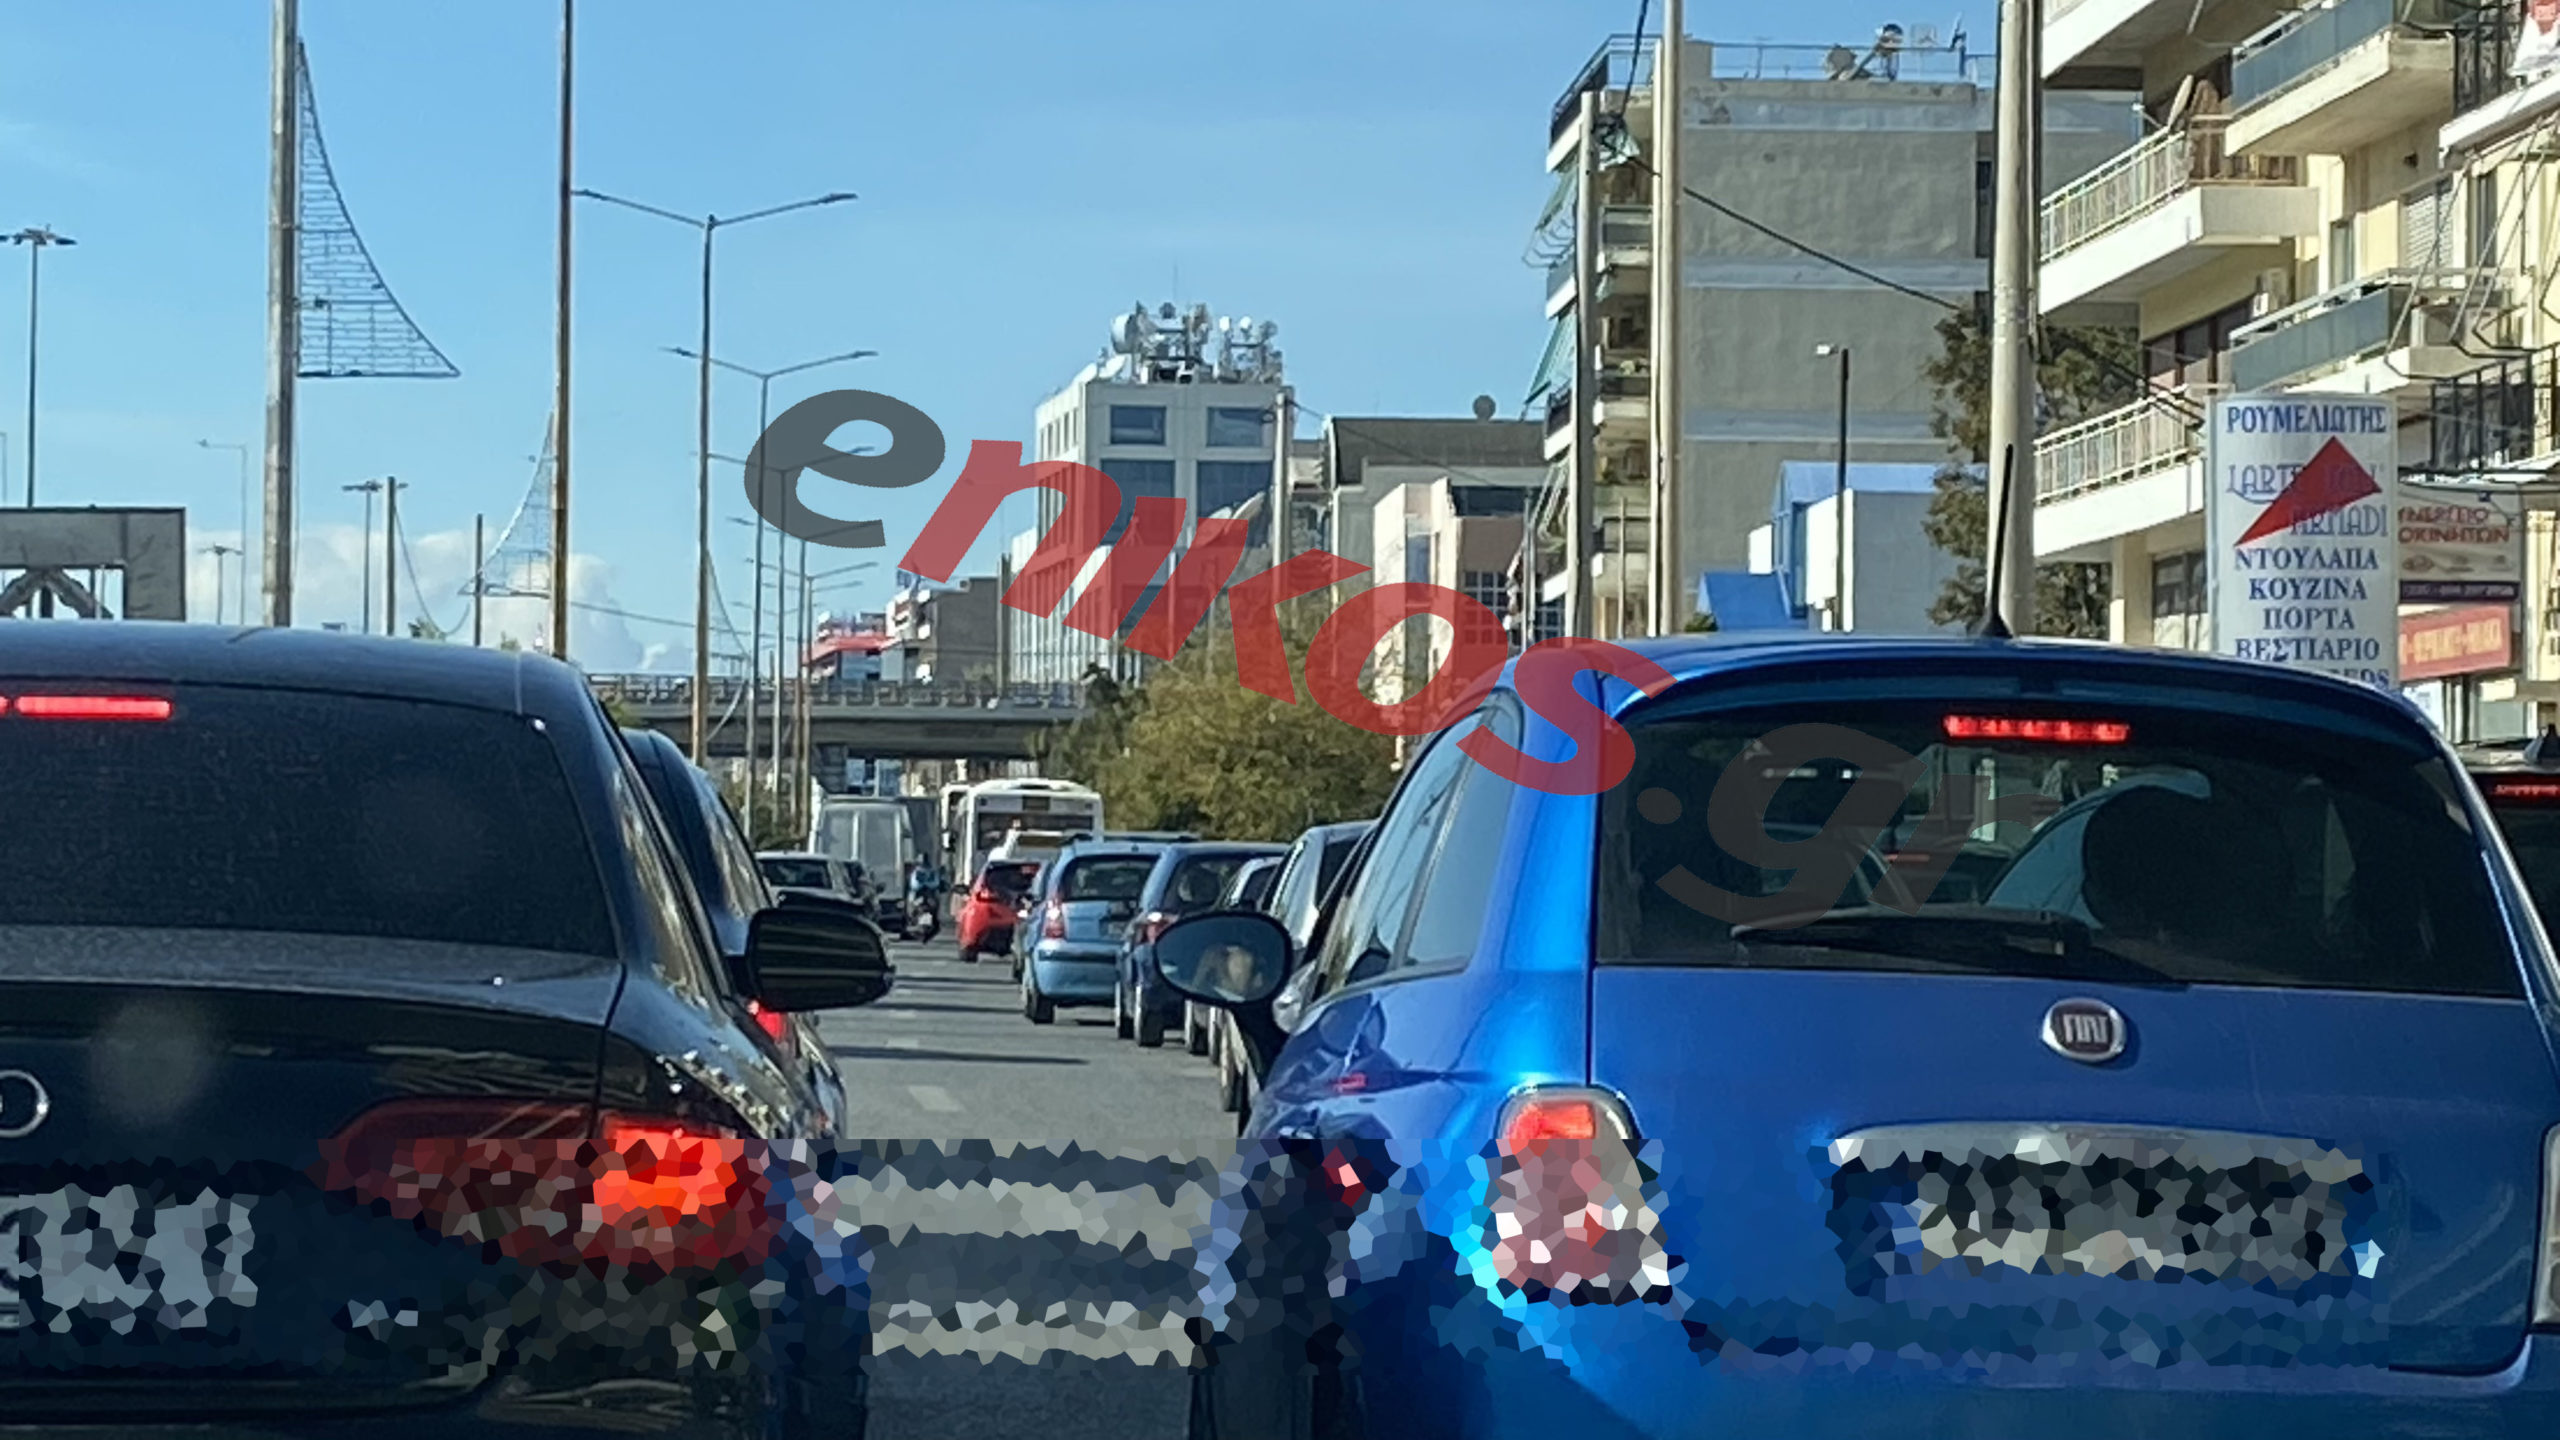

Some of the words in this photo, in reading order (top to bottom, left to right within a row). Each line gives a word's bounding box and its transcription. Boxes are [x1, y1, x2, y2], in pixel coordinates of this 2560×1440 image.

[2226, 405, 2387, 434] ΡΟΥΜΕΛΙΩΤΗΣ
[2234, 548, 2379, 572] ΝΤΟΥΛΑΠΑ
[2248, 577, 2368, 601] ΚΟΥΖΙΝΑ
[2263, 606, 2355, 630] ΠΟΡΤΑ
[2234, 637, 2380, 662] ΒΕΣΤΙΑΡΙΟ
